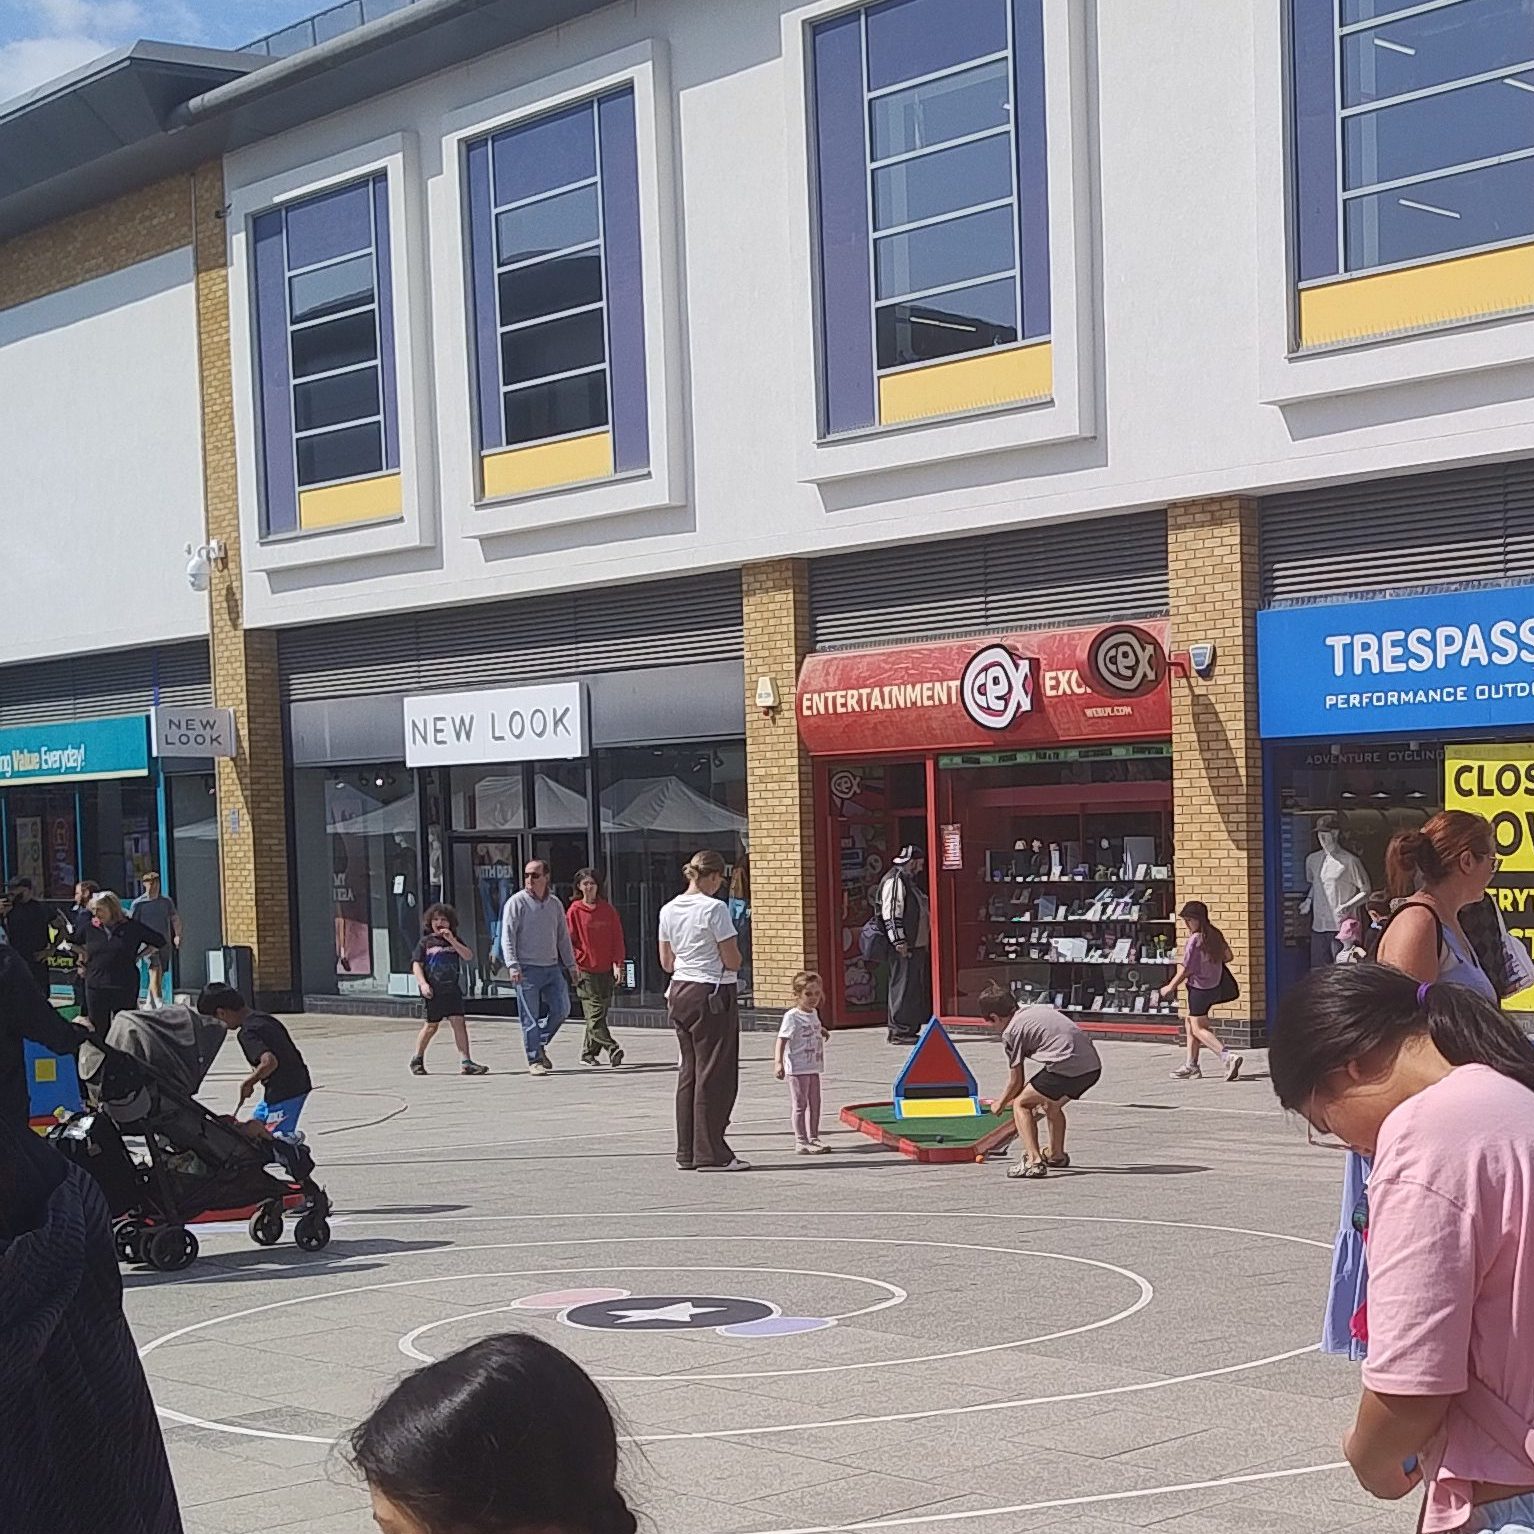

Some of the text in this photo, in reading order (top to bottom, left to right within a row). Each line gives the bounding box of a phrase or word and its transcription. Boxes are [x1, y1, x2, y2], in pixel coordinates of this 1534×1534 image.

[802, 679, 960, 716] ENTERTAINMENT
[1325, 686, 1467, 710] PERFORMANCE
[168, 718, 217, 731] NEW
[411, 706, 571, 746] NEW LOOK
[165, 734, 223, 746] LOOK
[12, 749, 40, 771] Value
[41, 743, 86, 773] Everyday!
[1304, 752, 1381, 766] ADVENTURE
[1388, 750, 1444, 763] CYCLING
